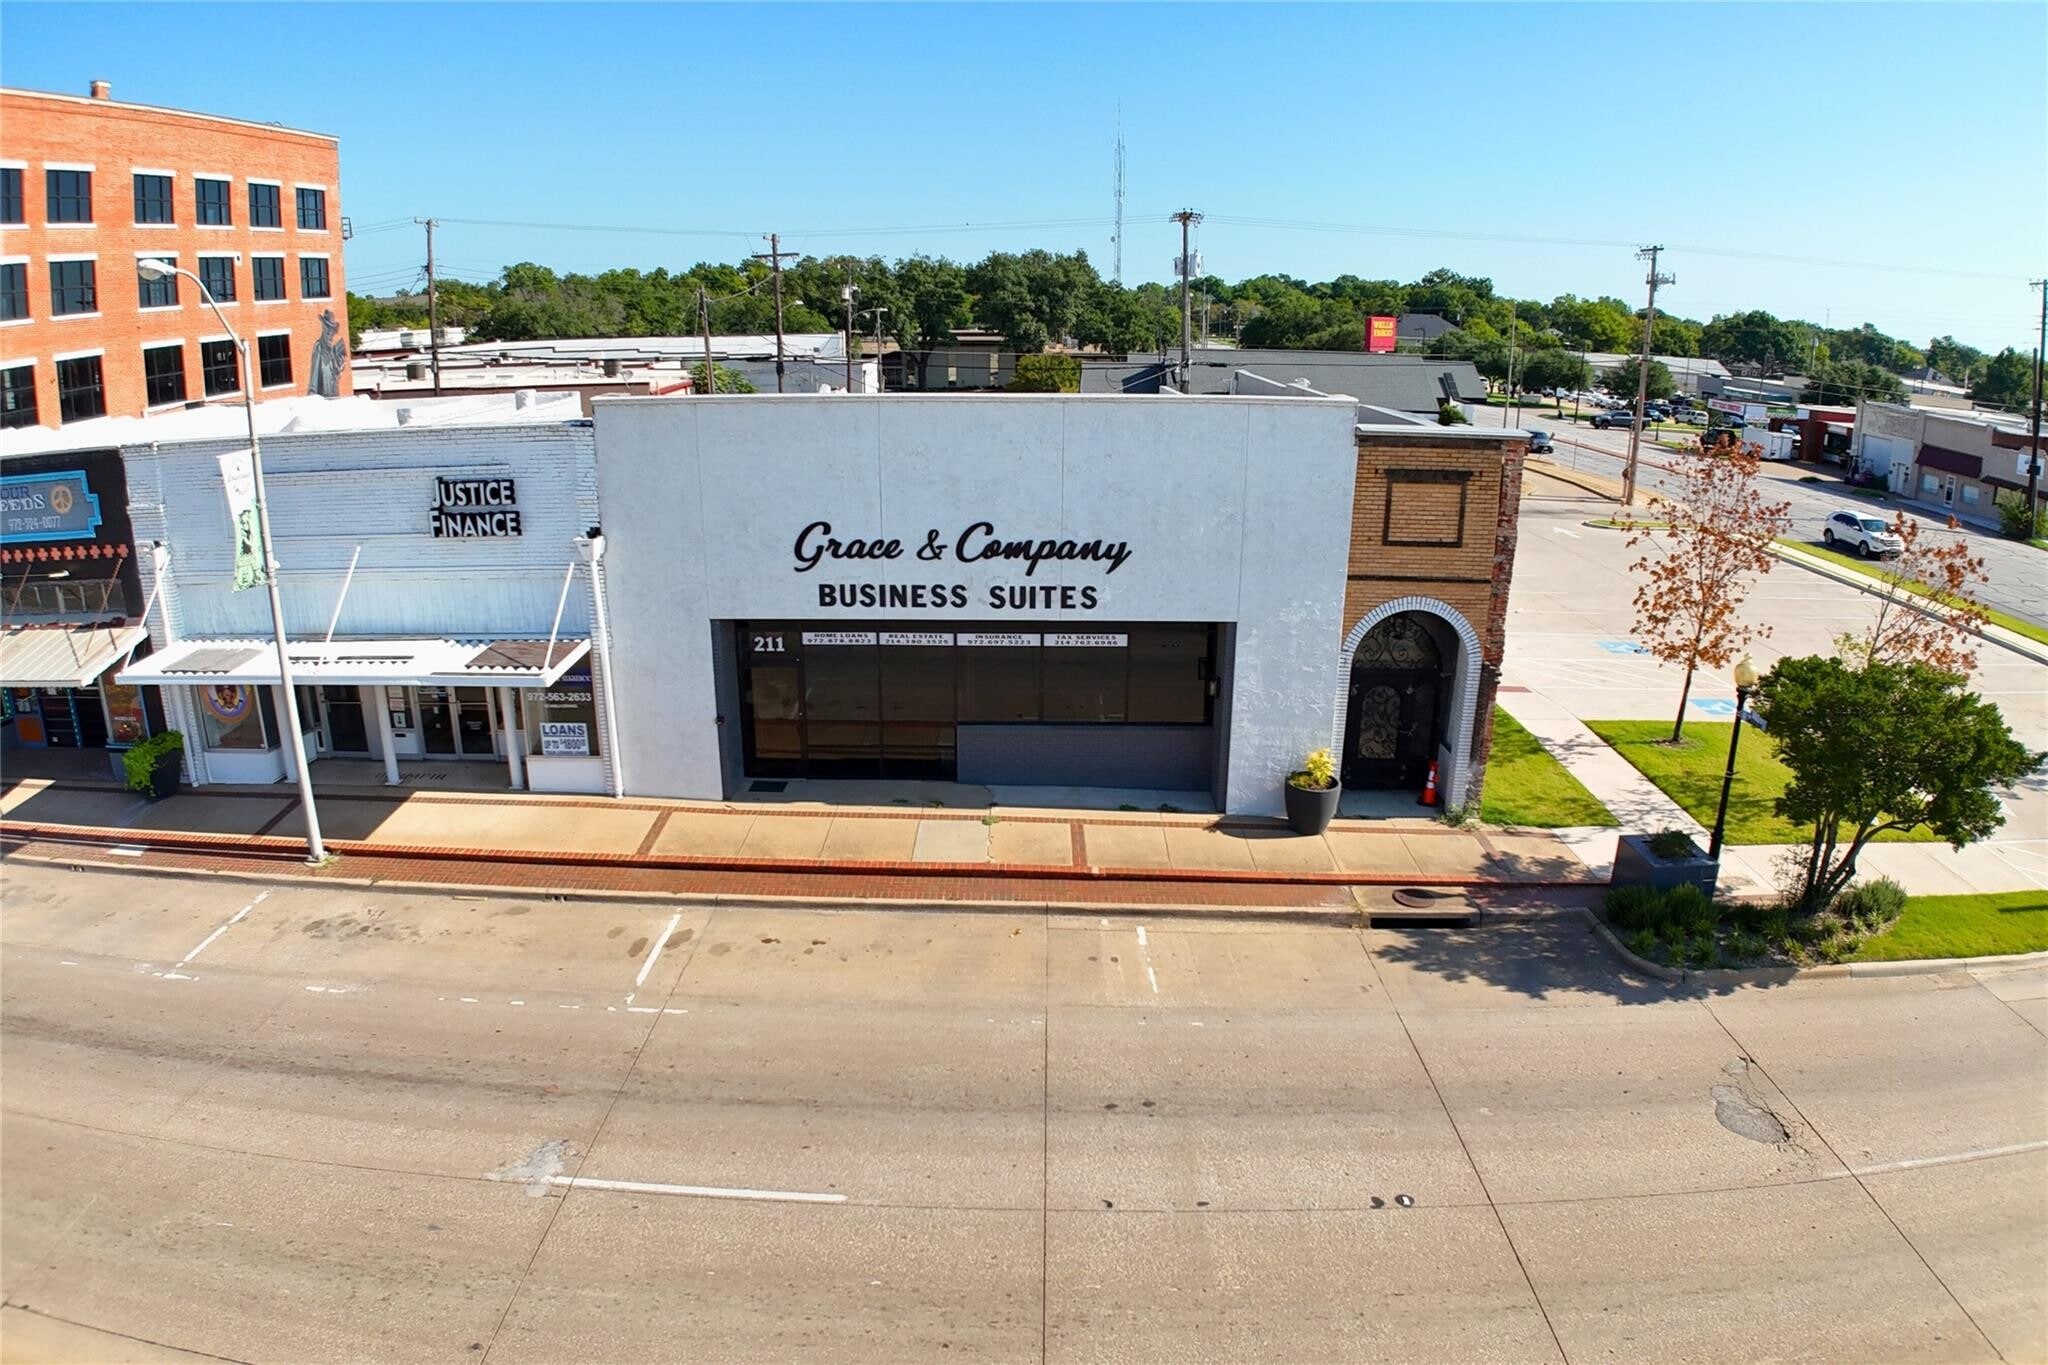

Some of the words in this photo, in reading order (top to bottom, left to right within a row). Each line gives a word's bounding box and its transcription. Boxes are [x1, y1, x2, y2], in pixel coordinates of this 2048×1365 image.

[431, 477, 515, 507] JUSTICE
[429, 509, 521, 537] FINANCE
[794, 521, 904, 572] Grace
[916, 529, 948, 561] &
[955, 521, 1133, 577] Company
[818, 583, 967, 608] BUSINESS
[988, 584, 1098, 609] SUITES
[754, 636, 785, 652] 211
[527, 692, 592, 701] 972-563-2633
[542, 725, 585, 736] LOANS
